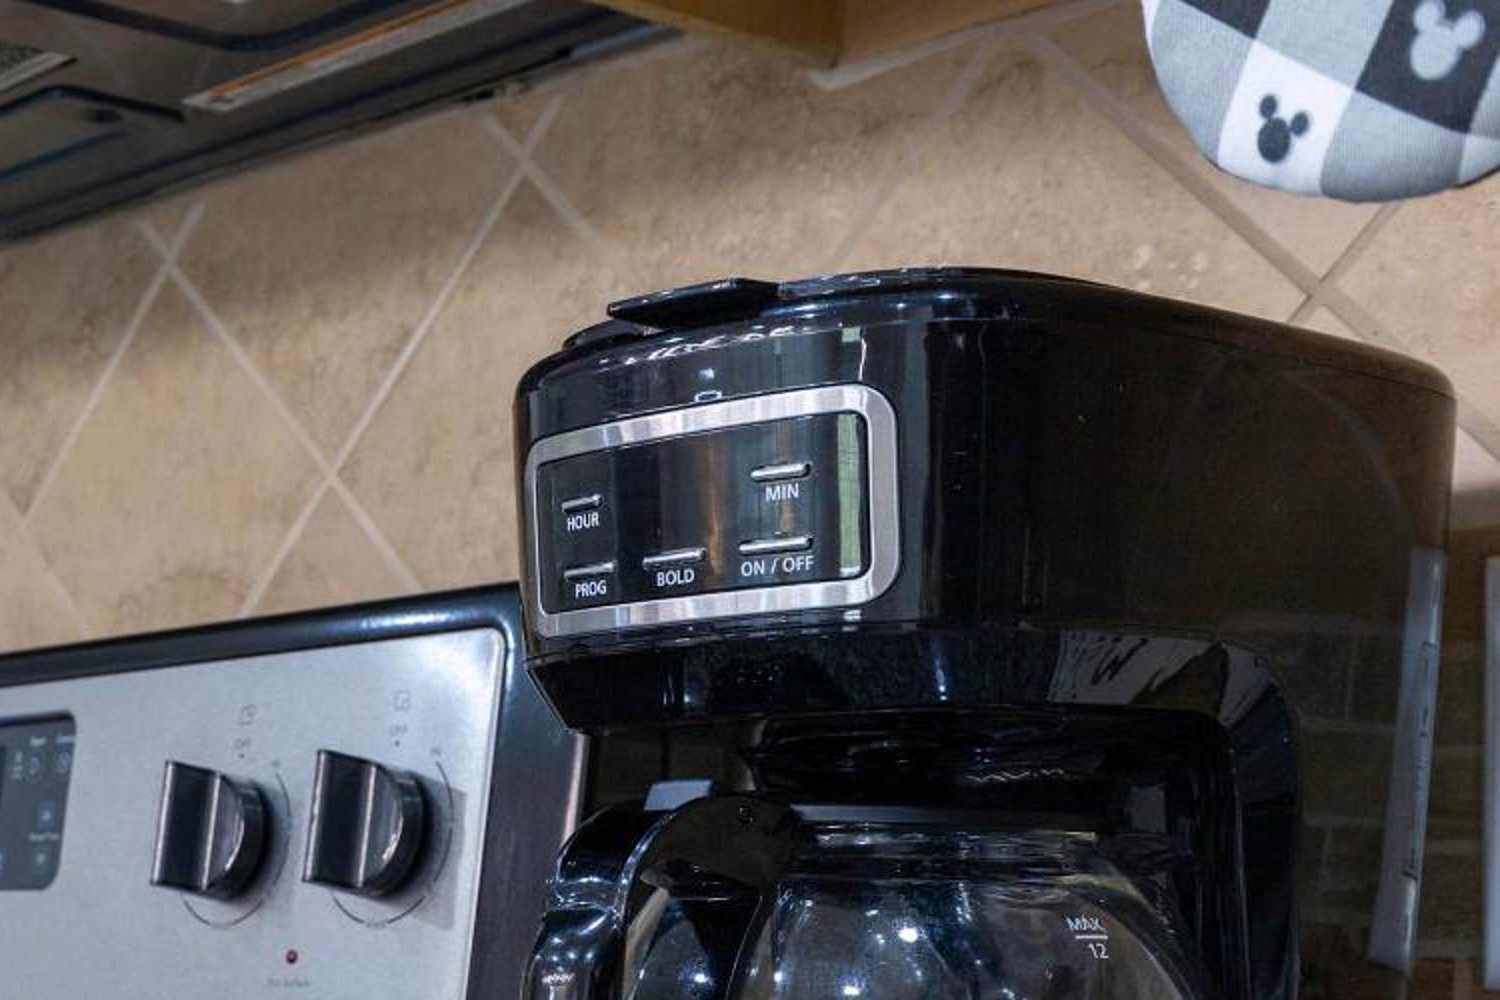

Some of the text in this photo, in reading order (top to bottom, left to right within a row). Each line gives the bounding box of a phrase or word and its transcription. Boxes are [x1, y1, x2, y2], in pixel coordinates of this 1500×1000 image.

[765, 484, 800, 502] MIN
[567, 513, 600, 532] HOUR
[740, 560, 766, 577] ON
[782, 555, 815, 573] OFF
[656, 568, 695, 588] BOLD
[574, 580, 607, 599] PROG
[1086, 942, 1109, 960] 12
